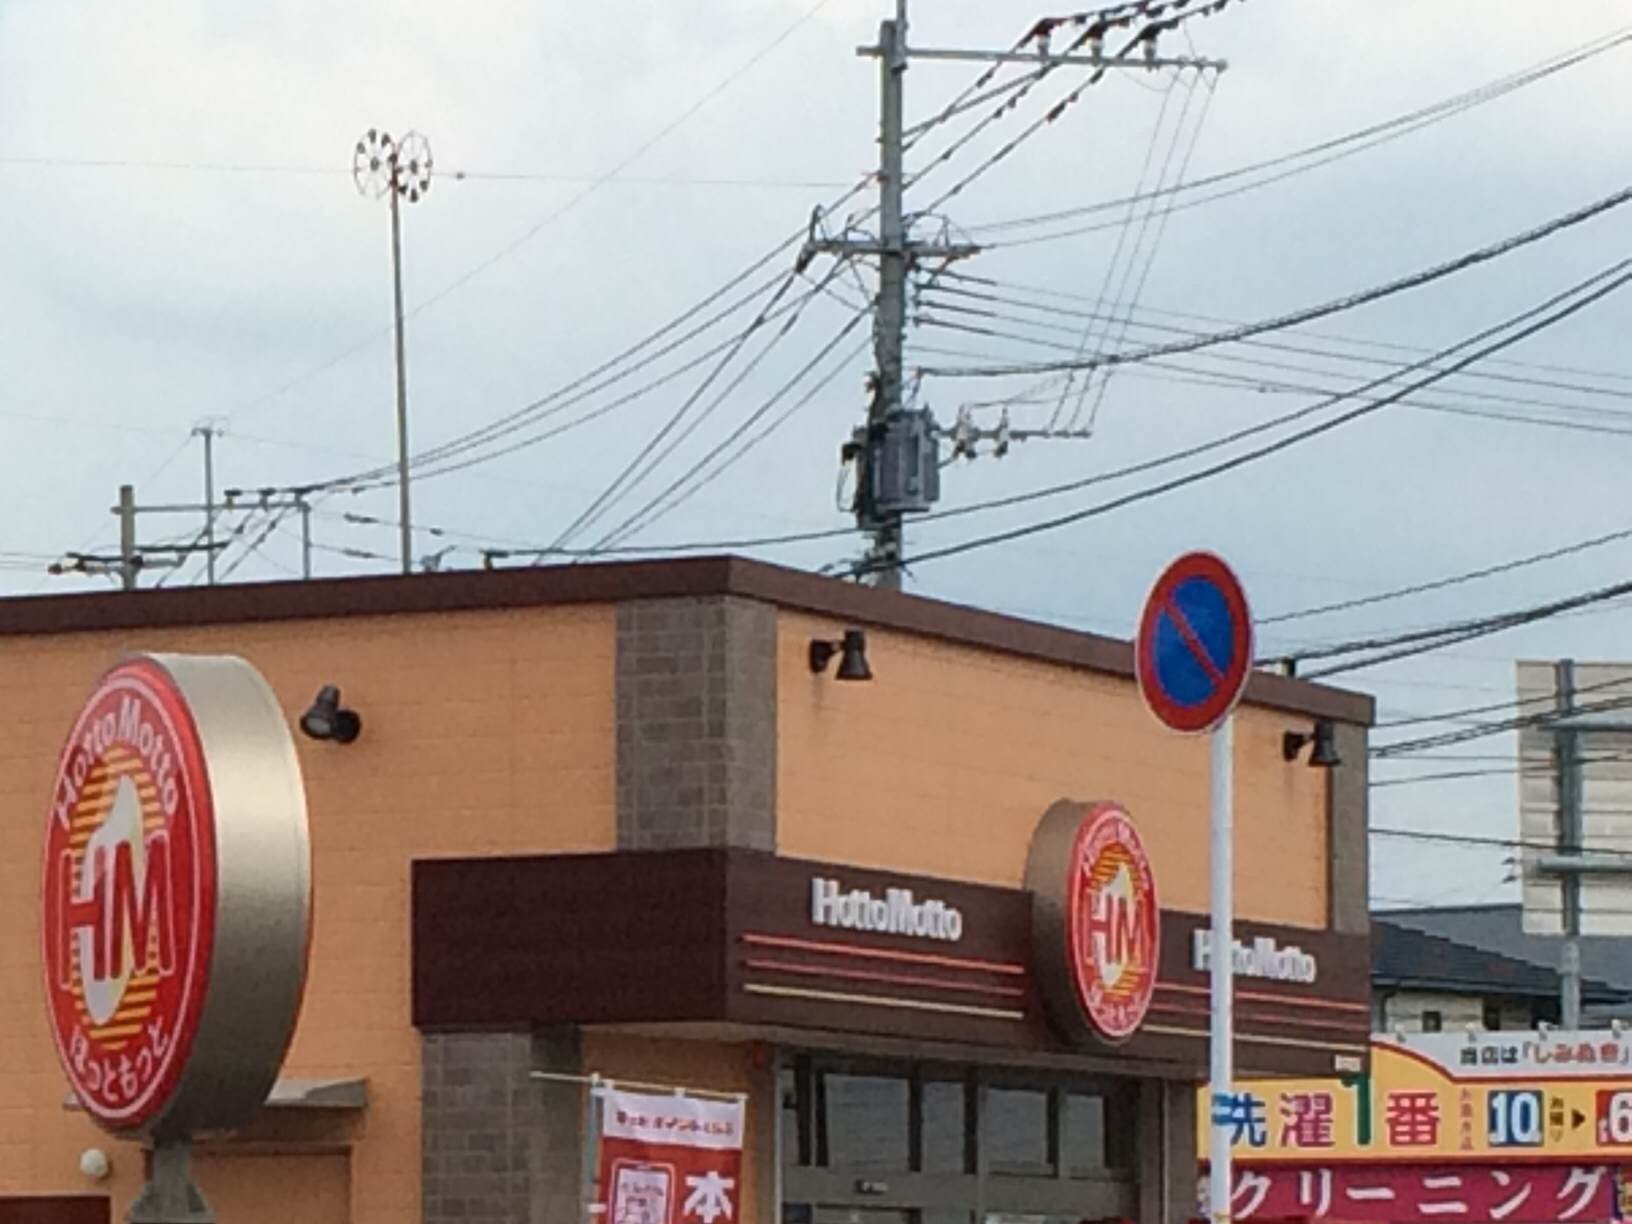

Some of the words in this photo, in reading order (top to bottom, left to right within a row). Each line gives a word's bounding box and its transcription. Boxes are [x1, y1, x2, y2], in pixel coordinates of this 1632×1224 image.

[54, 693, 180, 832] HottoMotto
[811, 876, 963, 942] HottoMotto
[1193, 929, 1317, 983] HtoMotto
[69, 1015, 168, 1102] ほっともっと
[1490, 1092, 1542, 1144] 10
[1230, 1166, 1608, 1222] クリーニング
